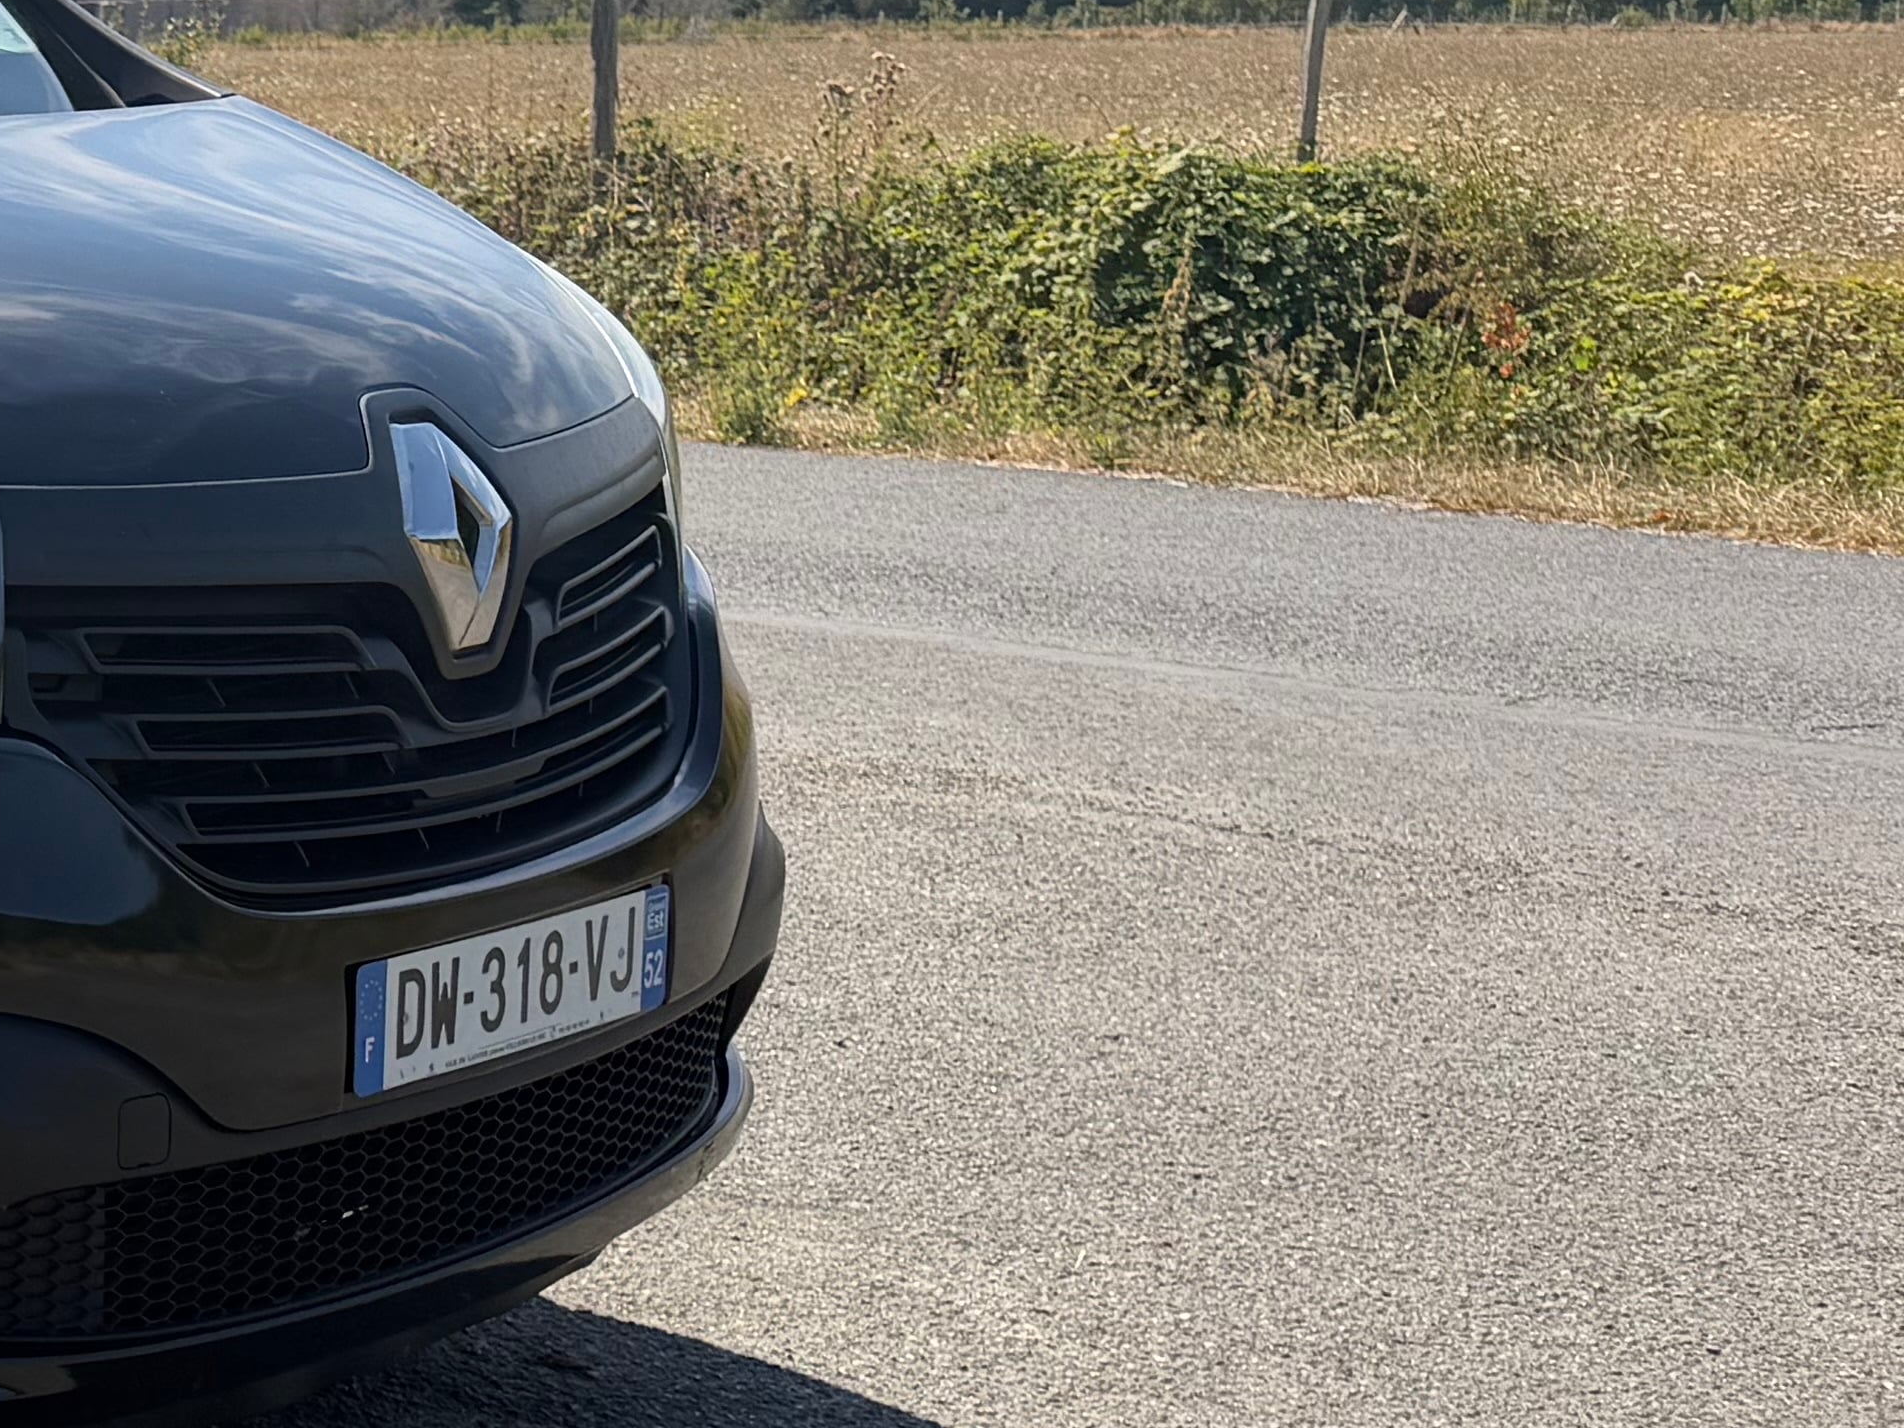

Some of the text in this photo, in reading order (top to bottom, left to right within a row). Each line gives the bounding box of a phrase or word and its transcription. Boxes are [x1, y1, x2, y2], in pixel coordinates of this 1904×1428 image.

[647, 910, 664, 930] Est
[396, 906, 636, 1060] DW-318-VJ
[644, 948, 663, 988] 52
[365, 1036, 376, 1063] F
